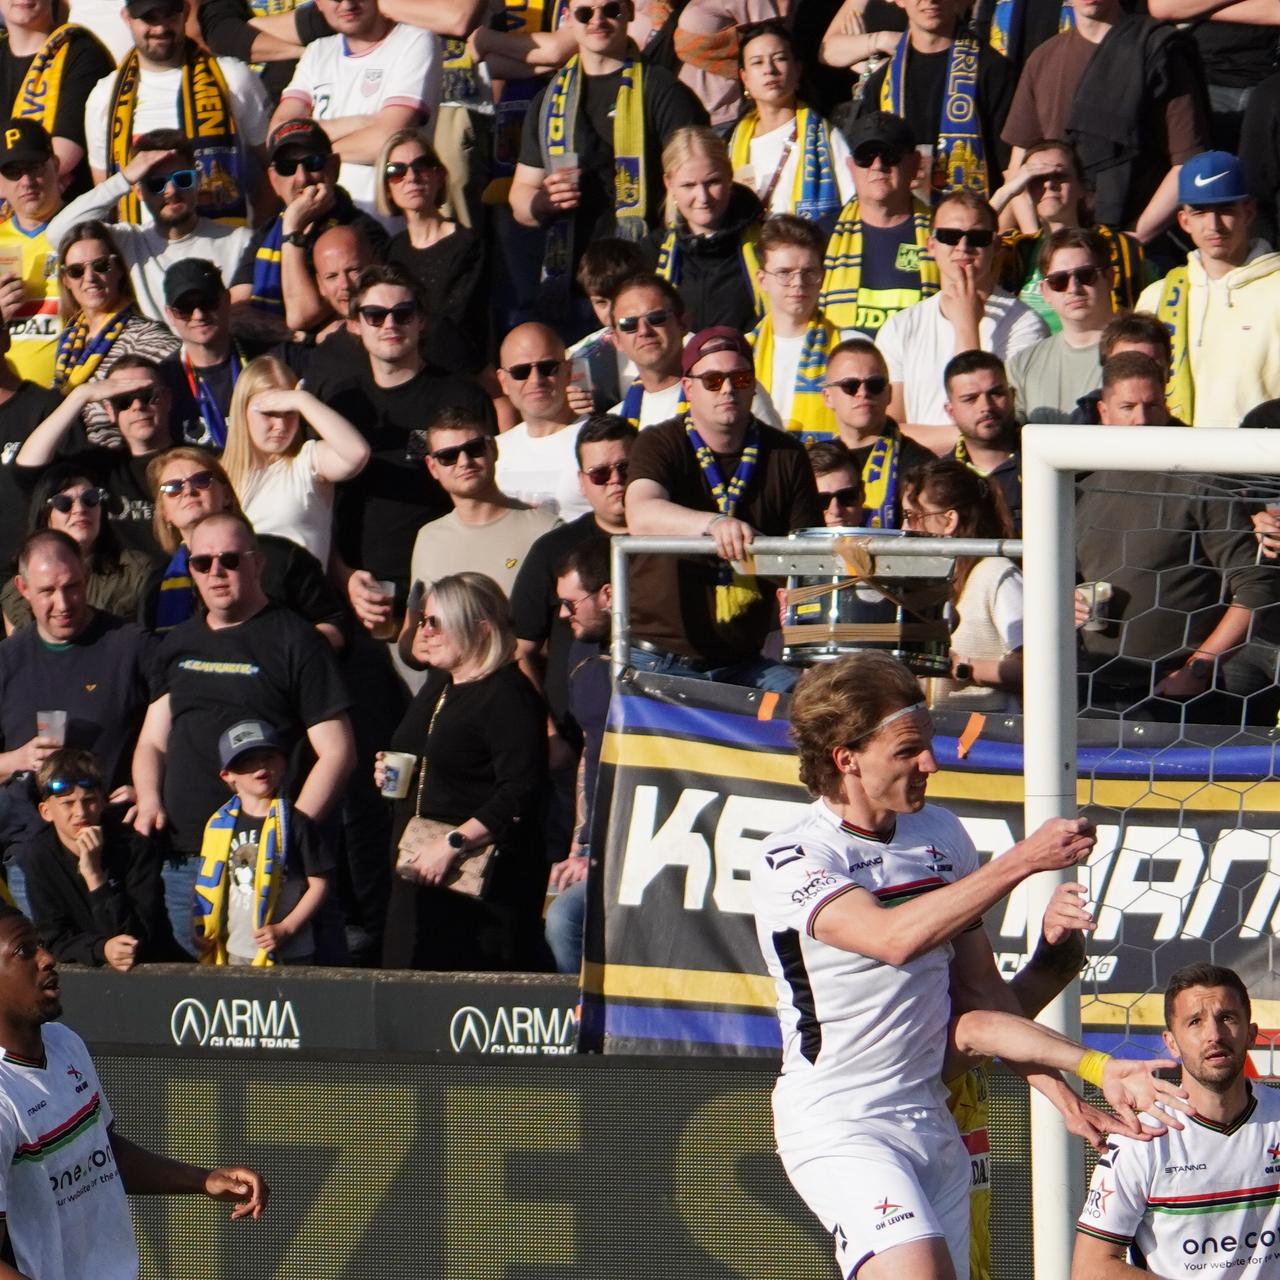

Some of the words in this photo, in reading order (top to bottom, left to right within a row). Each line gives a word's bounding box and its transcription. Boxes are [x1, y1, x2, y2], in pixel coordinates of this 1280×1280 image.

[5, 128, 20, 149] P
[210, 999, 299, 1037] ARMA
[490, 1007, 578, 1044] ARMA
[210, 1036, 255, 1047] GLOBAL
[259, 1038, 299, 1048] TRADE
[1164, 1163, 1207, 1174] STANNO
[875, 1220, 887, 1231] OH
[887, 1211, 915, 1226] LEUVEN
[1184, 1261, 1207, 1271] Your
